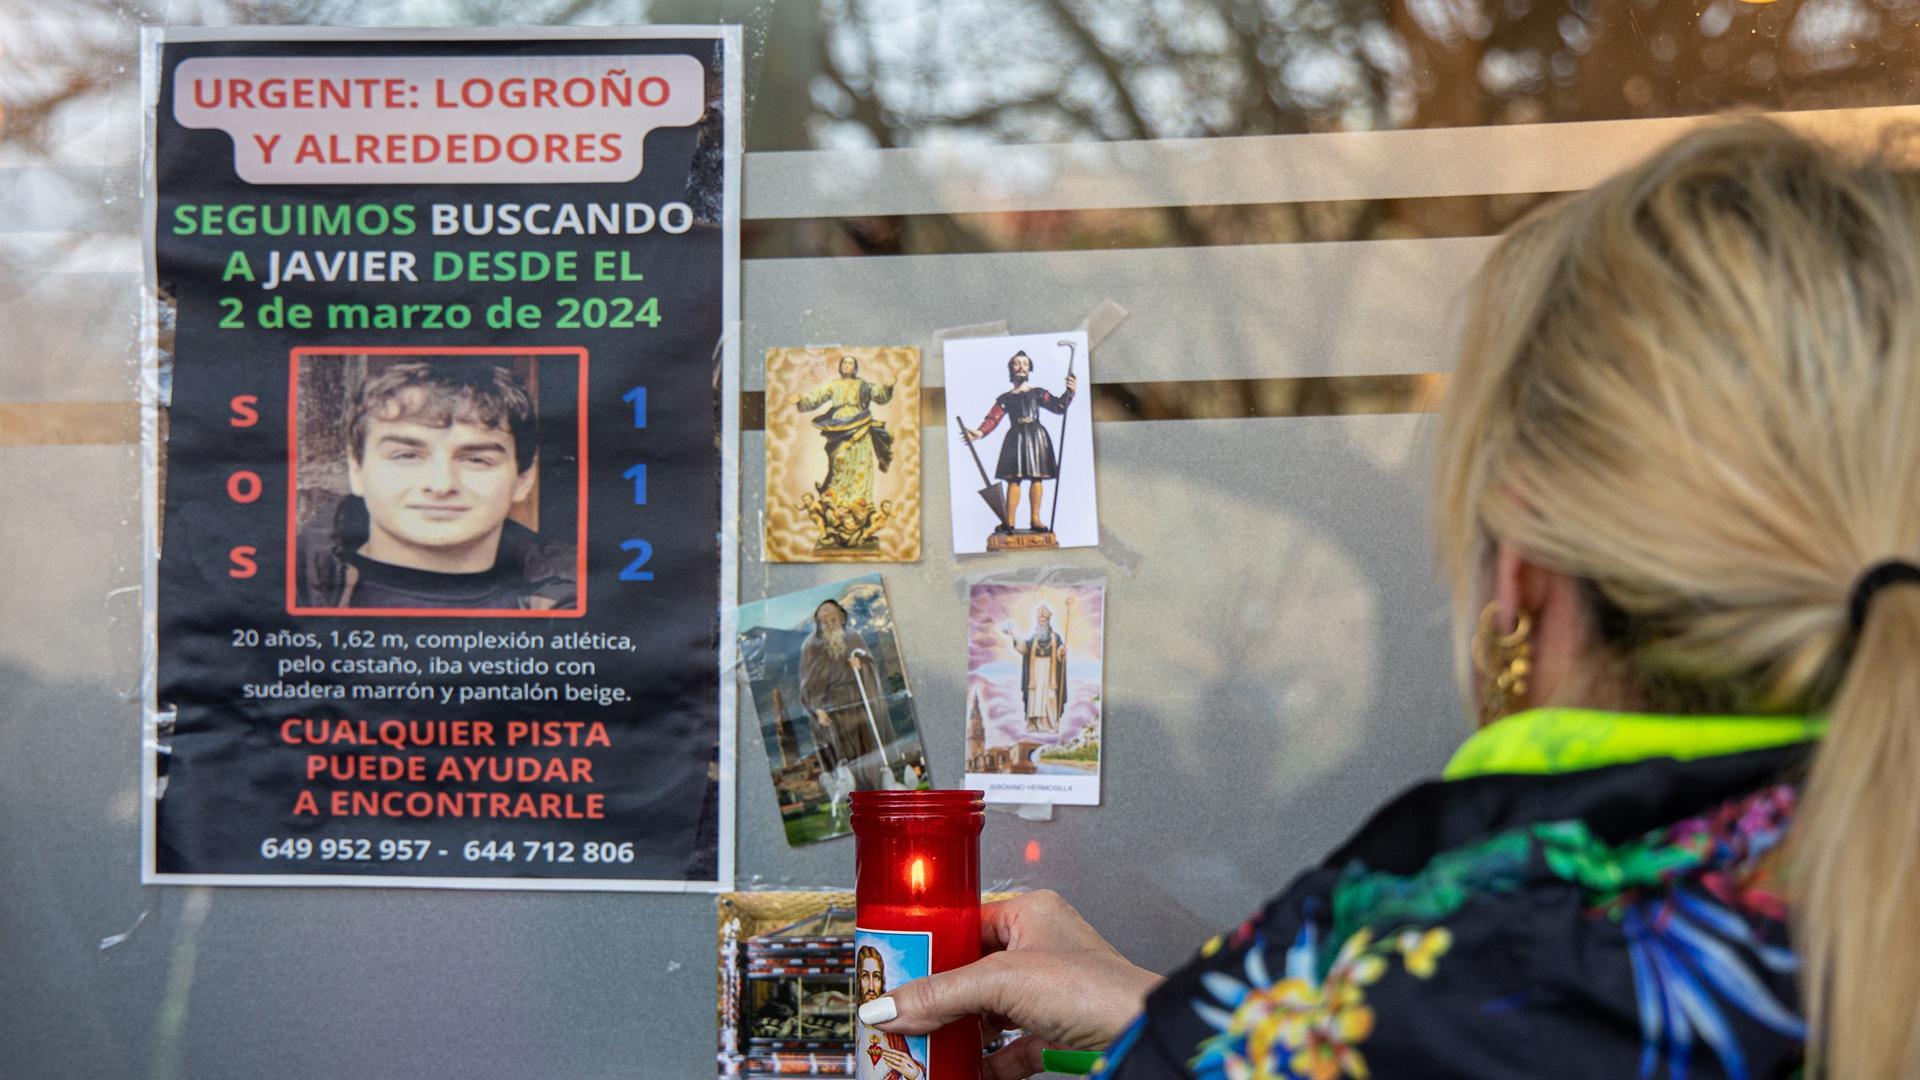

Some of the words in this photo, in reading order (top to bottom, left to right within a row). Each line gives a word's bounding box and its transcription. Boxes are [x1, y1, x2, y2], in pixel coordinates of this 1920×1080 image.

[194, 78, 418, 108] URGENTE:
[436, 69, 669, 108] LOGROÑO
[254, 135, 280, 164] Y
[294, 133, 621, 164] ALREDEDORES
[173, 204, 416, 235] SEGUIMOS
[432, 202, 693, 235] BUSCANDO
[223, 251, 255, 281] A
[263, 251, 418, 289] JAVIER
[434, 251, 577, 281] DESDE
[595, 251, 643, 281] EL
[219, 298, 244, 328] 2
[258, 296, 312, 328] de
[328, 304, 471, 328] marzo
[486, 296, 541, 328] de
[556, 297, 661, 328] 2024
[623, 387, 646, 428] 1
[623, 464, 647, 505] 1
[619, 539, 653, 580] 2
[232, 629, 259, 647] 20
[265, 630, 322, 649] años,
[331, 630, 375, 649] 1,62
[382, 634, 408, 650] m,
[415, 631, 544, 652] complexión
[551, 632, 636, 651] atlética,
[278, 655, 325, 676] pelo
[331, 657, 422, 675] castaño,
[429, 657, 462, 673] iba
[468, 657, 554, 675] vestido
[560, 661, 595, 675] con
[243, 681, 345, 698] sudadera
[352, 682, 434, 699] marrón
[441, 687, 453, 704] y
[459, 683, 557, 704] pantalón
[565, 683, 631, 705] beige.
[281, 718, 495, 748] CUALQUIER
[508, 721, 611, 747] PISTA
[307, 755, 425, 781] PUEDE
[437, 756, 593, 782] AYUDAR
[294, 790, 319, 815] A
[331, 791, 604, 818] ENCONTRARLE
[261, 838, 312, 859] 649
[320, 839, 371, 859] 952
[379, 840, 431, 860] 957
[464, 841, 515, 861] 644
[523, 841, 574, 862] 712
[583, 842, 634, 863] 806
